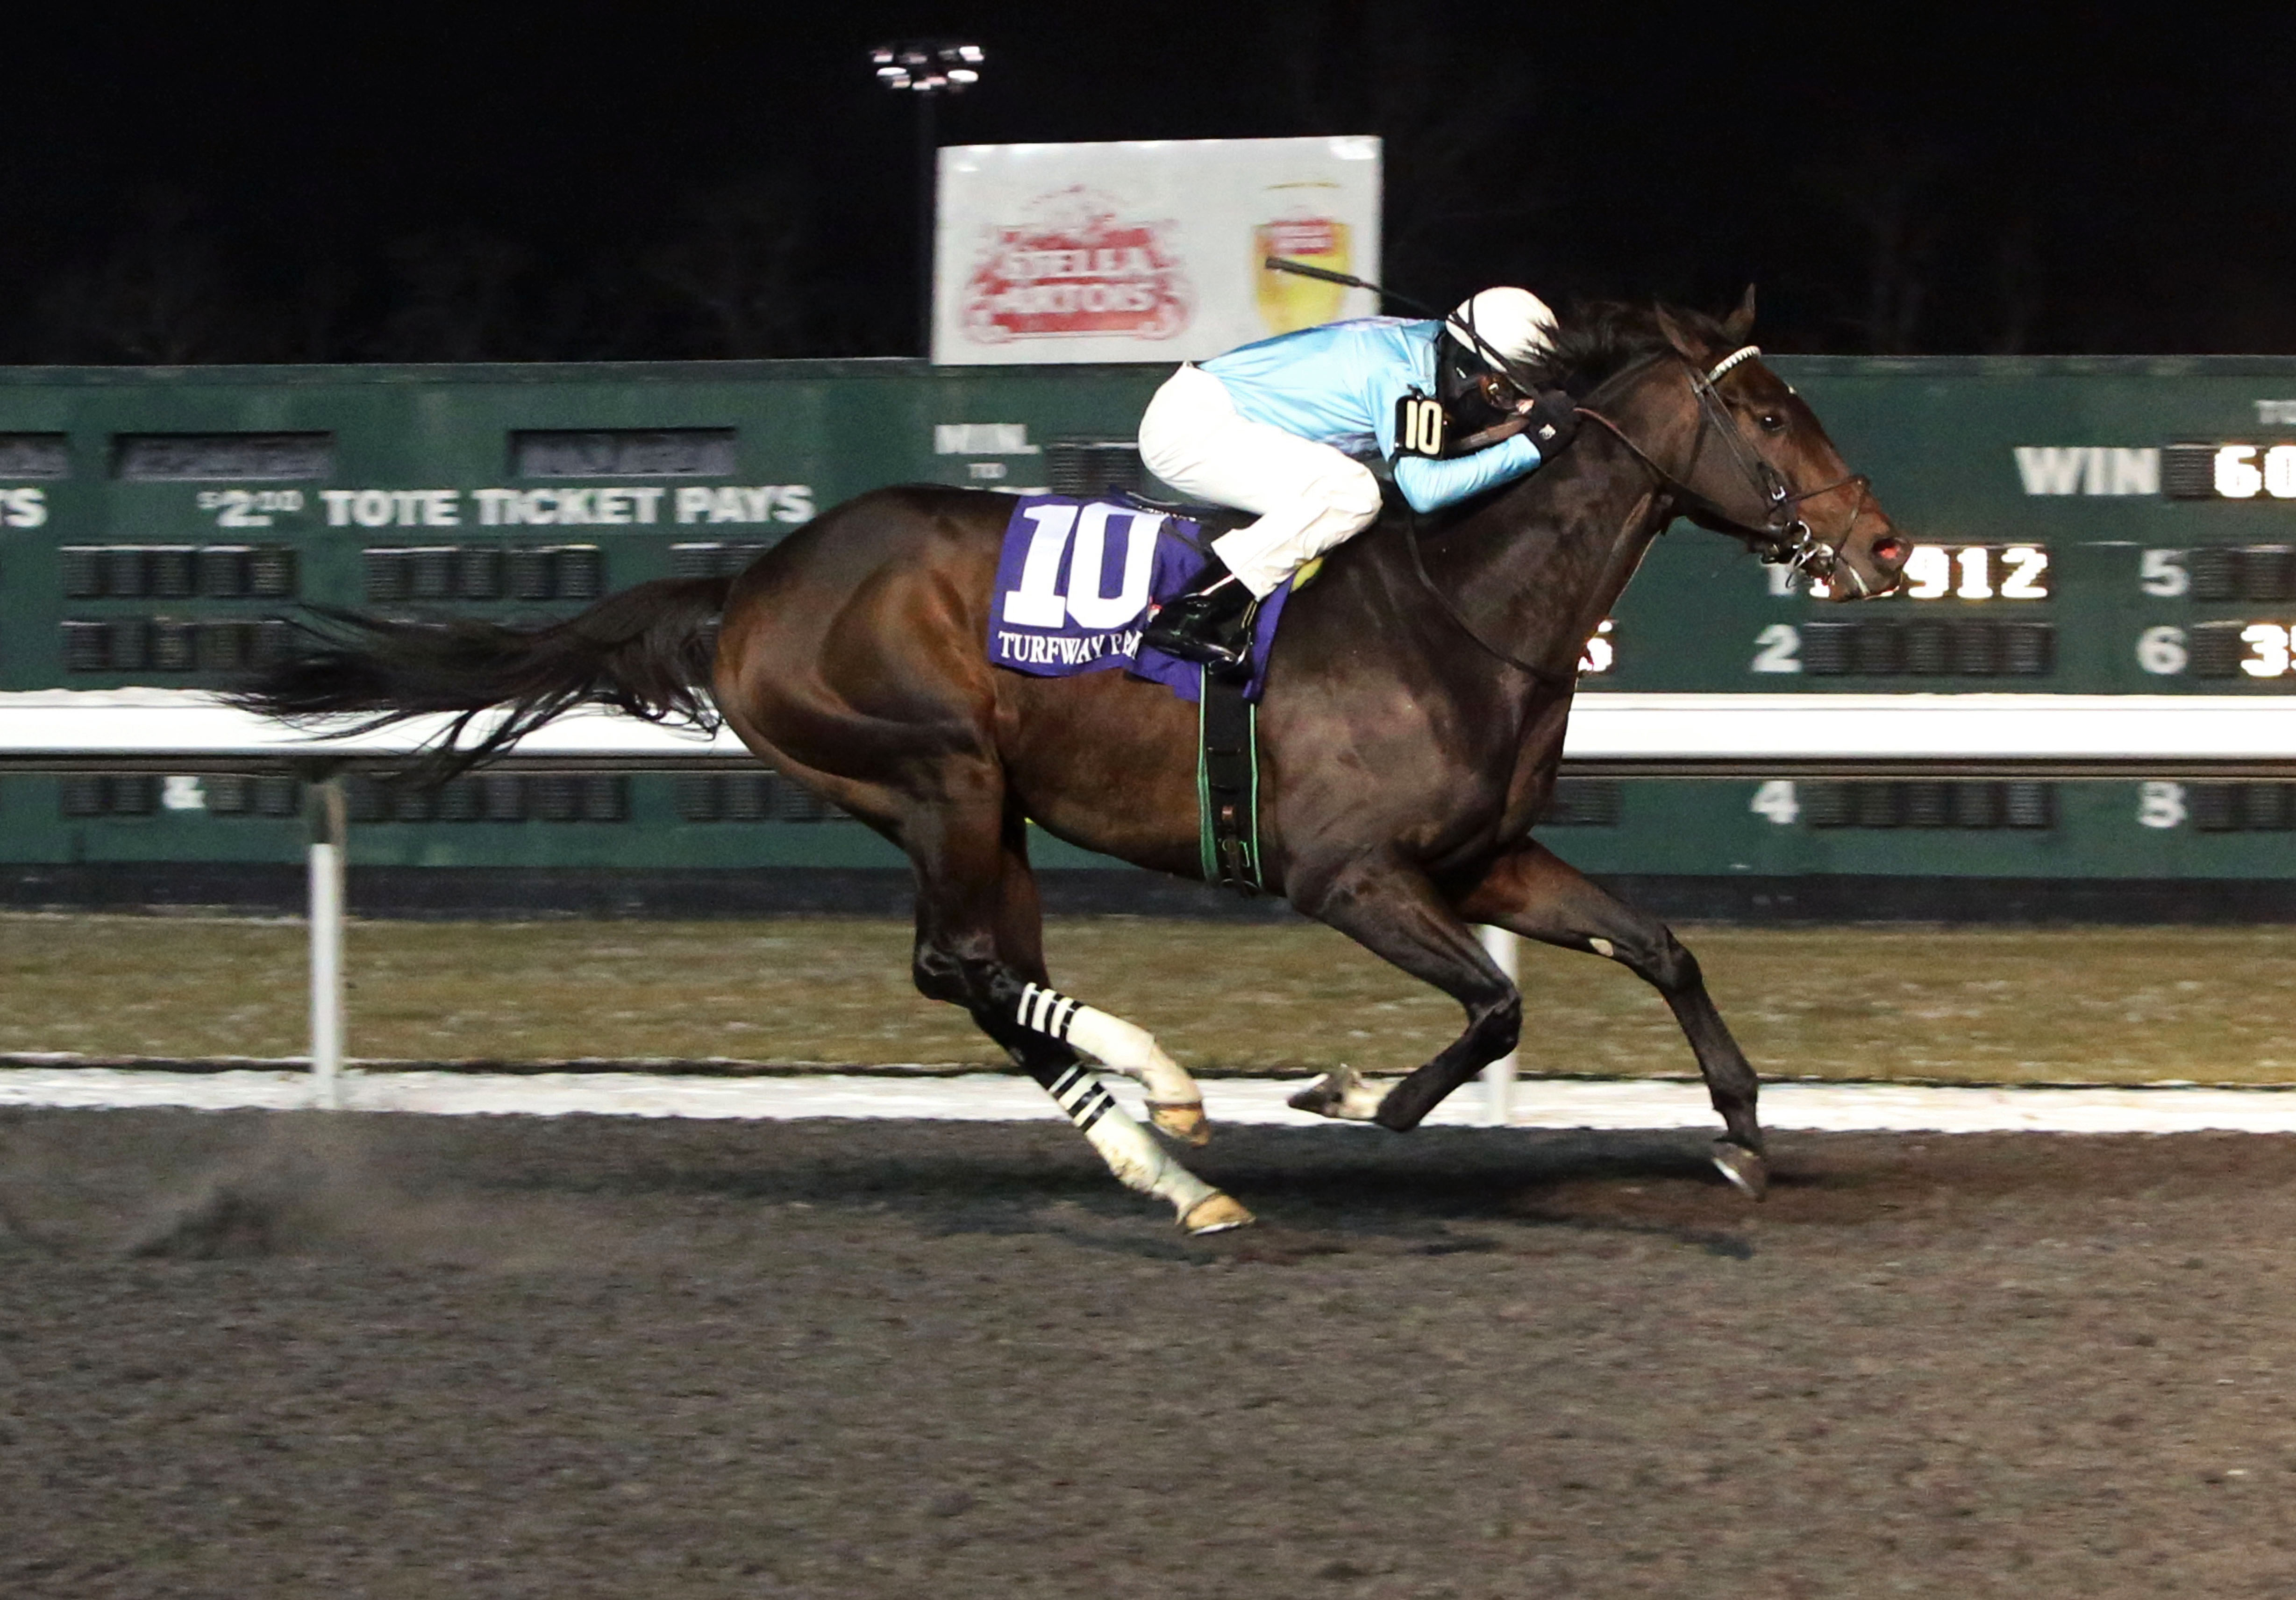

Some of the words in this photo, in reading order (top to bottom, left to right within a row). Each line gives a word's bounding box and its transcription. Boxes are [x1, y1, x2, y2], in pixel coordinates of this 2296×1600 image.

[1405, 400, 1443, 456] 10
[2013, 446, 2161, 495] WIN
[318, 489, 460, 526] TOTE
[471, 487, 666, 525] TICKET
[675, 485, 817, 524] PAYS
[1003, 502, 1171, 629] 10
[2140, 549, 2190, 597] 5
[998, 630, 1105, 664] TURFWAY
[1752, 624, 1803, 672] 2
[2137, 625, 2188, 675] 6
[1750, 780, 1800, 823] 4
